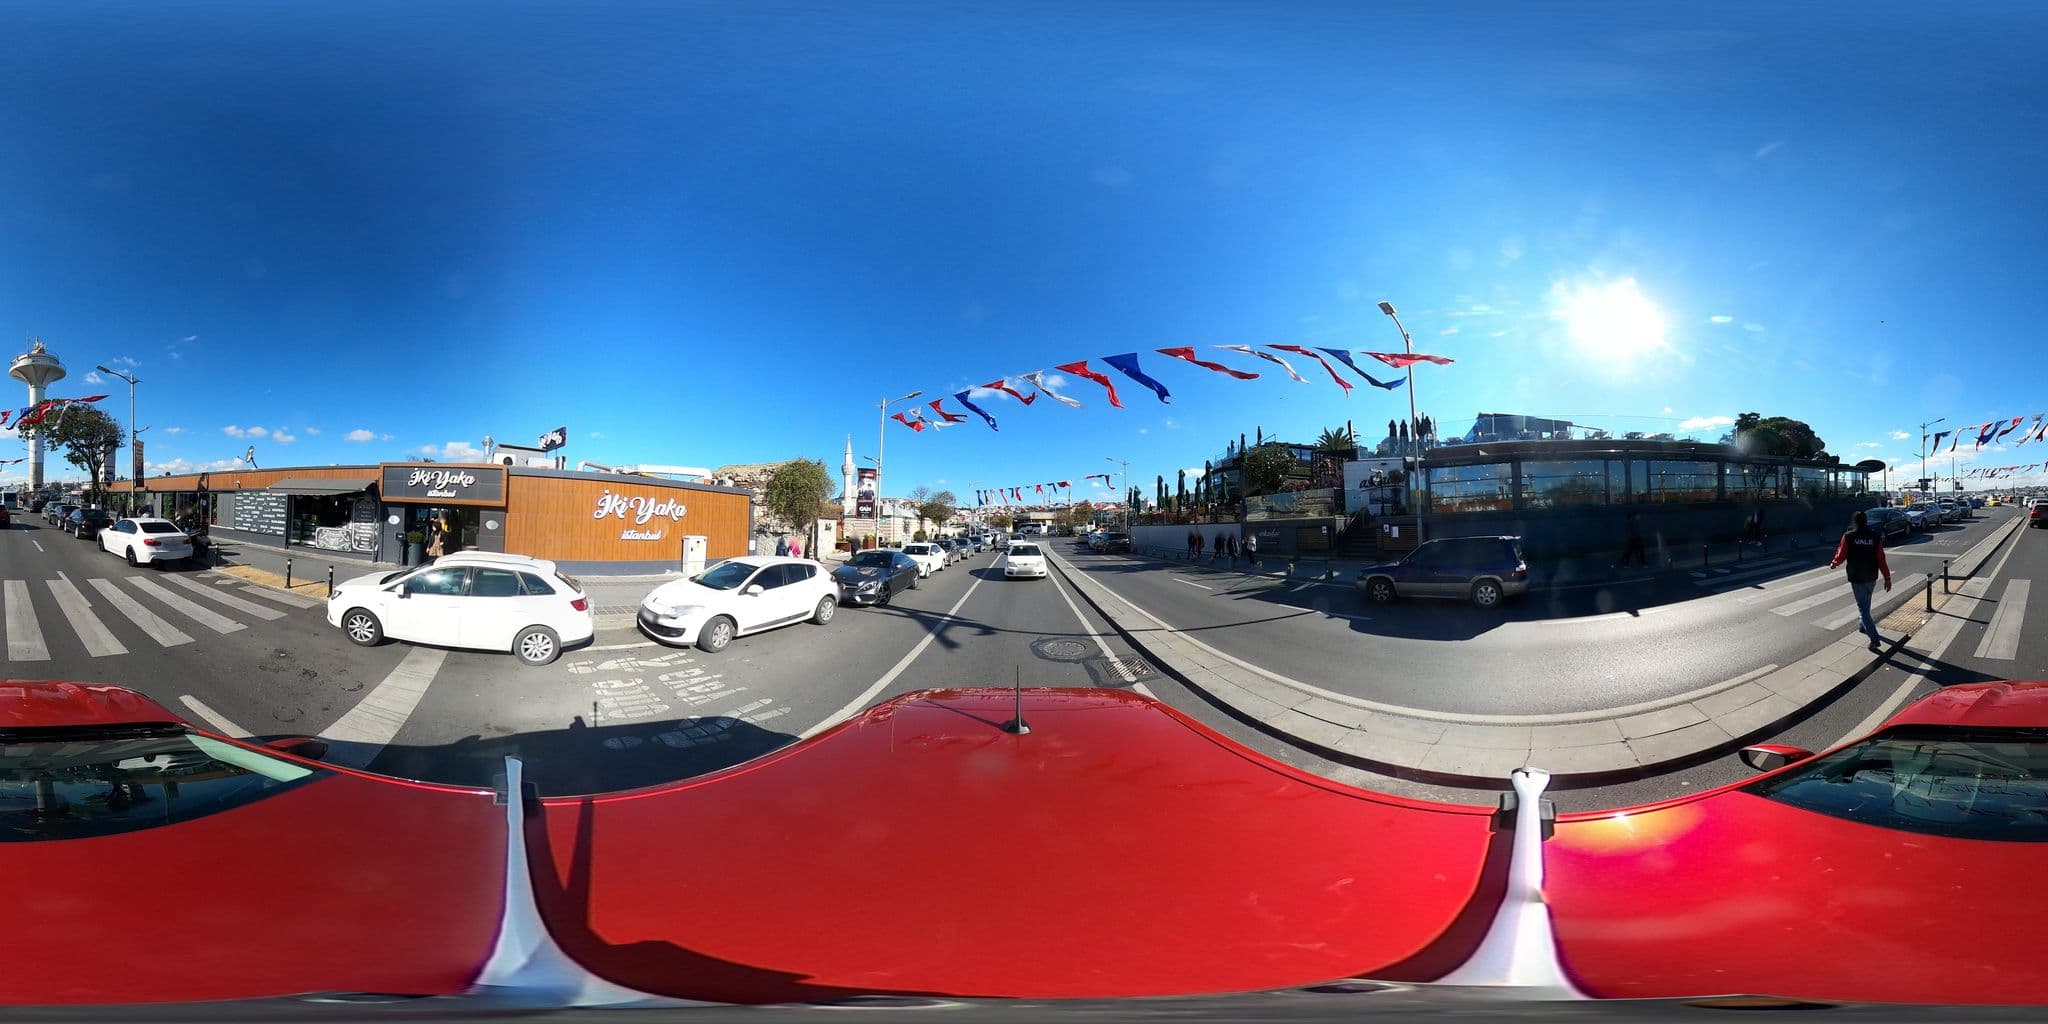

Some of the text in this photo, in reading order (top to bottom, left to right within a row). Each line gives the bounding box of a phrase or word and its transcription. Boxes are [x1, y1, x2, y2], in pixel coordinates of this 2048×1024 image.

[430, 470, 476, 490] Yaka
[593, 489, 688, 525] İki Yaka
[620, 529, 662, 541] istanbul
